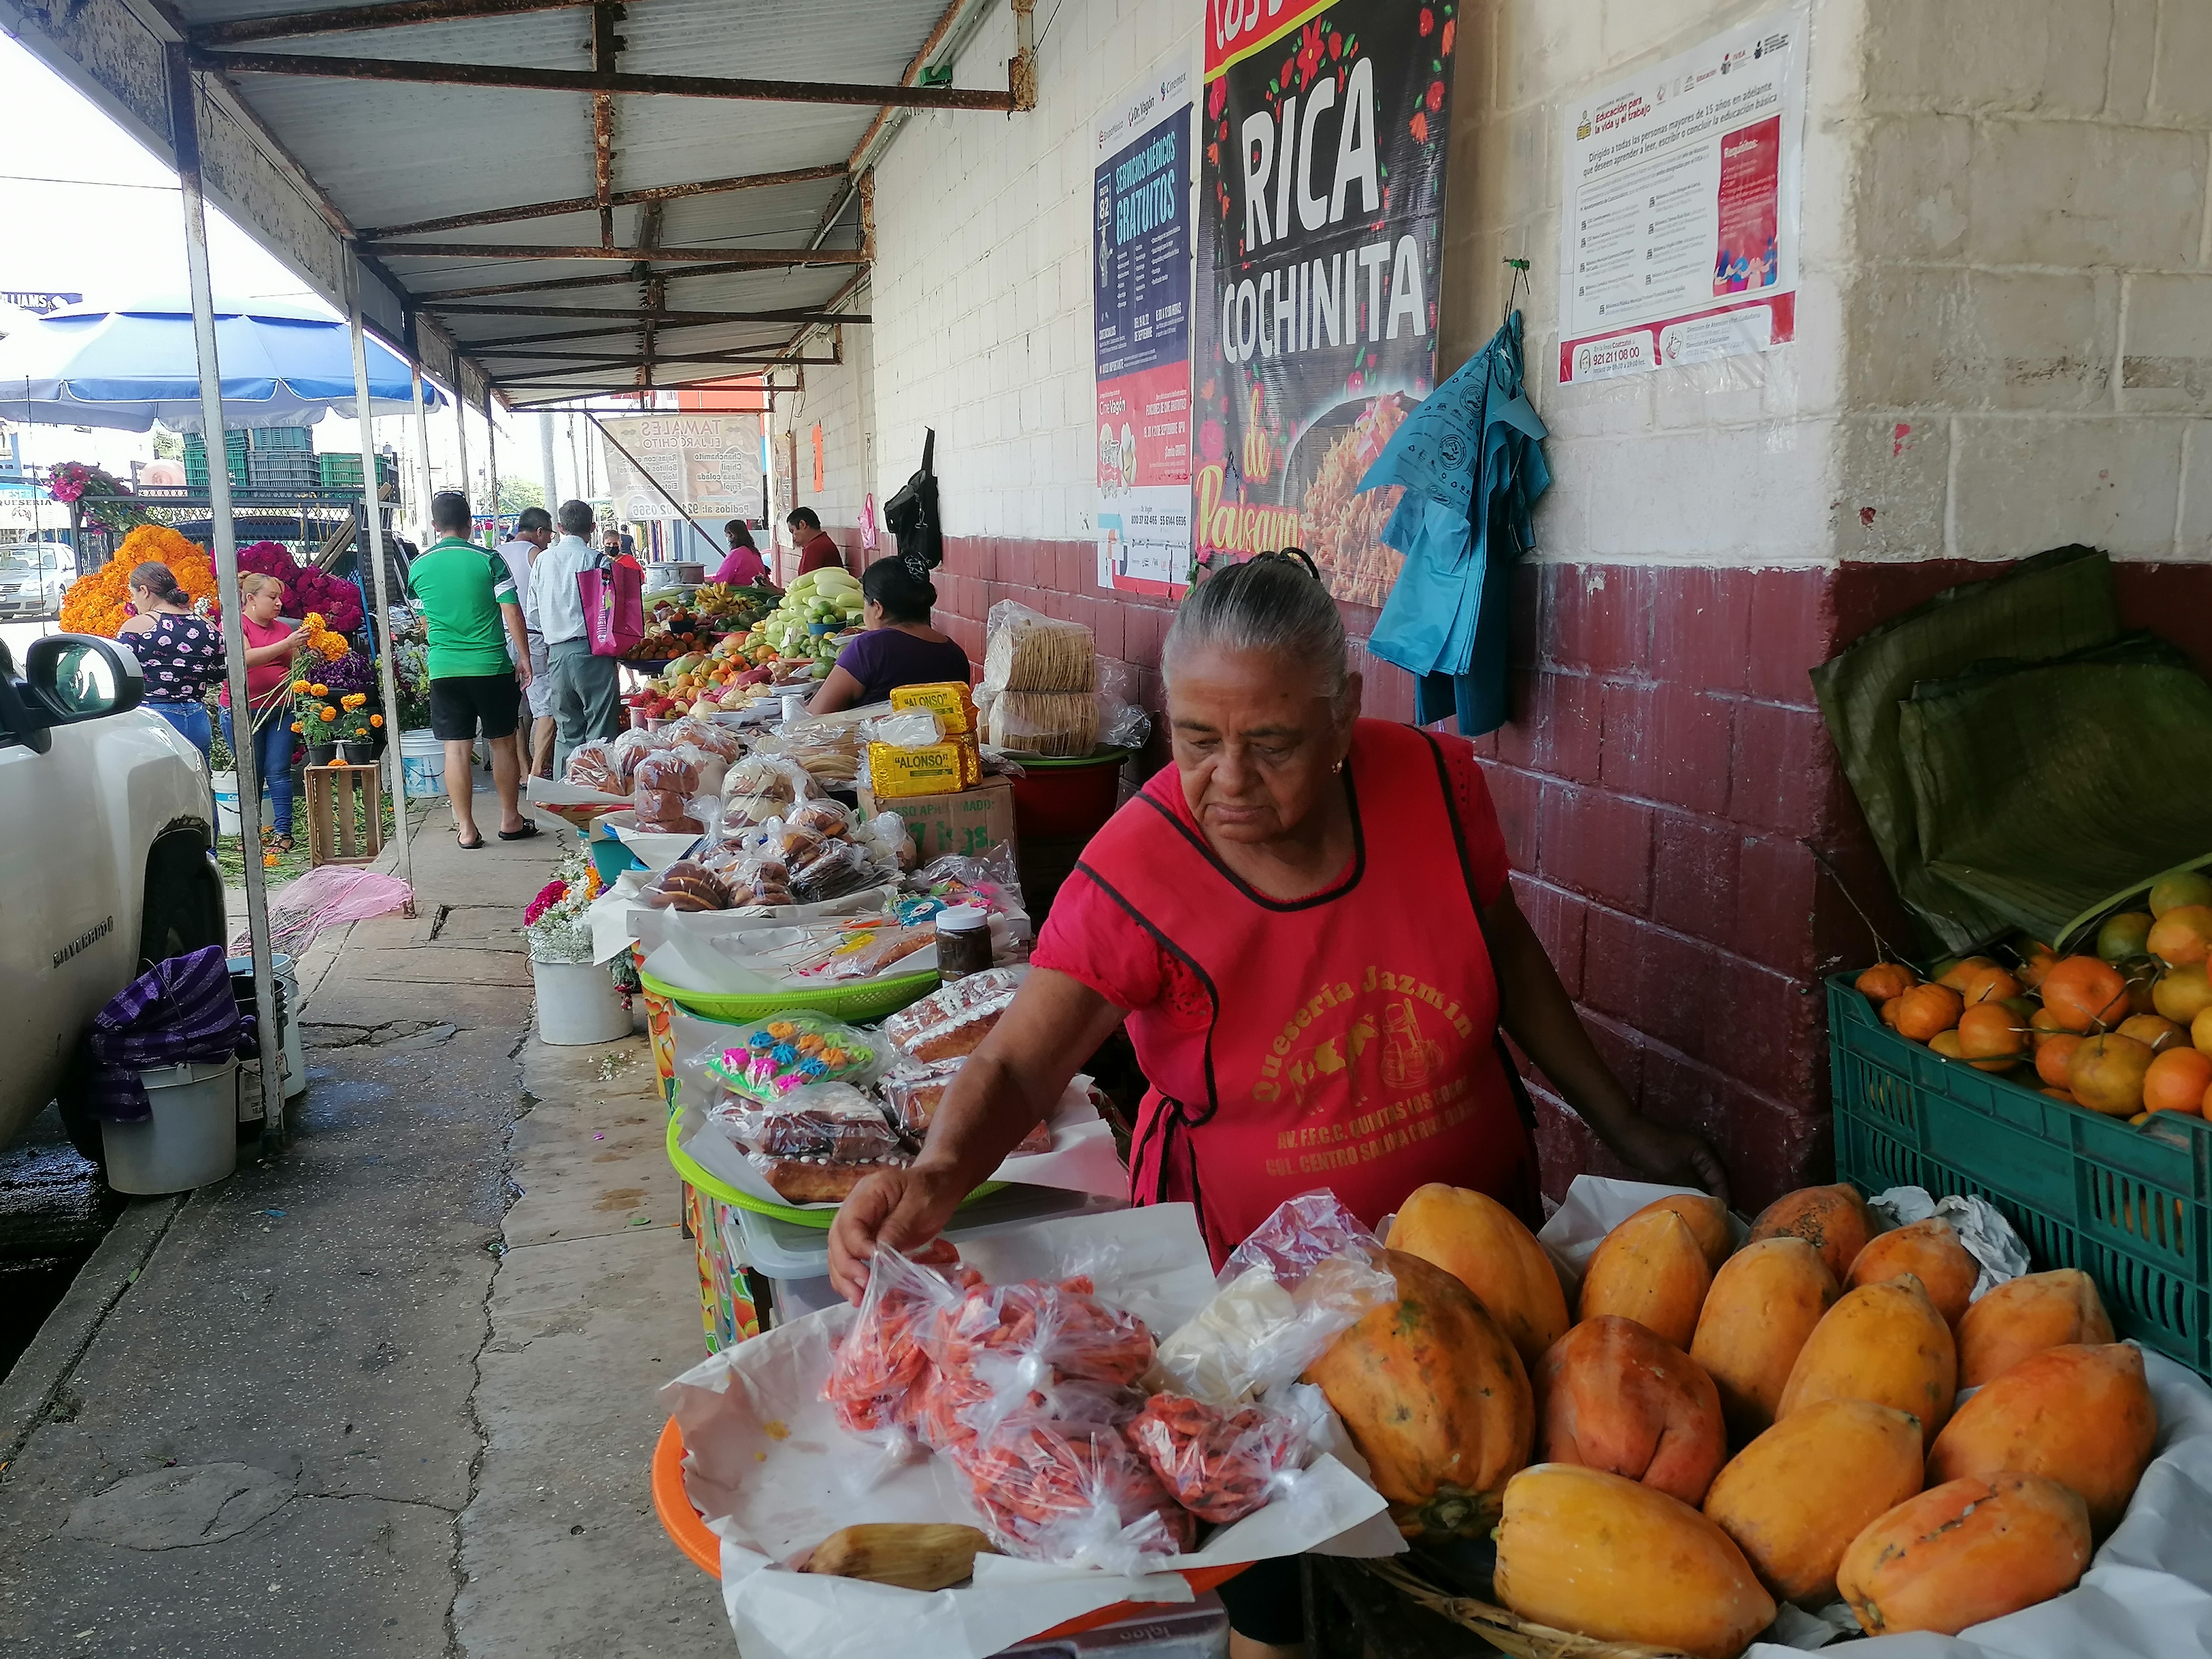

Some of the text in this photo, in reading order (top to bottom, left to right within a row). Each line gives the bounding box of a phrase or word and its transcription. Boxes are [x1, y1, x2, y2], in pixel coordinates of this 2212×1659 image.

[1140, 95, 1155, 120] Vagón
[1589, 145, 1610, 164] Dirigido
[1616, 137, 1631, 152] todas
[1641, 124, 1667, 143] personas
[1668, 113, 1694, 135] mayores
[1695, 107, 1704, 119] de
[1705, 103, 1713, 116] 15
[1715, 96, 1731, 112] años
[1733, 94, 1741, 105] en
[1743, 80, 1772, 101] adelante
[1595, 102, 1651, 134] la vida y el trabajo
[1596, 96, 1642, 123] Educación para
[1242, 58, 1379, 252] RICA
[1583, 166, 1593, 179] que
[1594, 157, 1612, 172] deseen
[1614, 146, 1639, 166] aprender
[1644, 139, 1658, 154] leer,
[1658, 130, 1680, 147] escribir
[1687, 117, 1712, 135] concluir
[1713, 114, 1719, 125] la
[1720, 100, 1755, 123] educación
[1755, 91, 1777, 109] básica
[1116, 131, 1176, 195] SERVICIOS MÉDICOS
[1100, 196, 1109, 219] 82
[1117, 167, 1175, 246] GRATUITOS
[1223, 234, 1426, 363] COCHINITA
[1593, 346, 1639, 366] 921 211 08 00
[1099, 397, 1125, 418] CineVagón
[1244, 389, 1270, 477] de
[1160, 516, 1165, 525] 55
[1196, 465, 1303, 554] Paisano
[895, 754, 948, 769] “ALONSO”
[1277, 1130, 1298, 1150] AV.
[1301, 1124, 1348, 1147] F.F.C.C.
[1349, 1101, 1407, 1139] QUINTAS
[1407, 1092, 1433, 1114] LOS
[1265, 1158, 1297, 1176] COL.
[1300, 1146, 1358, 1173] CENTRO
[1359, 1129, 1409, 1161] SALINA
